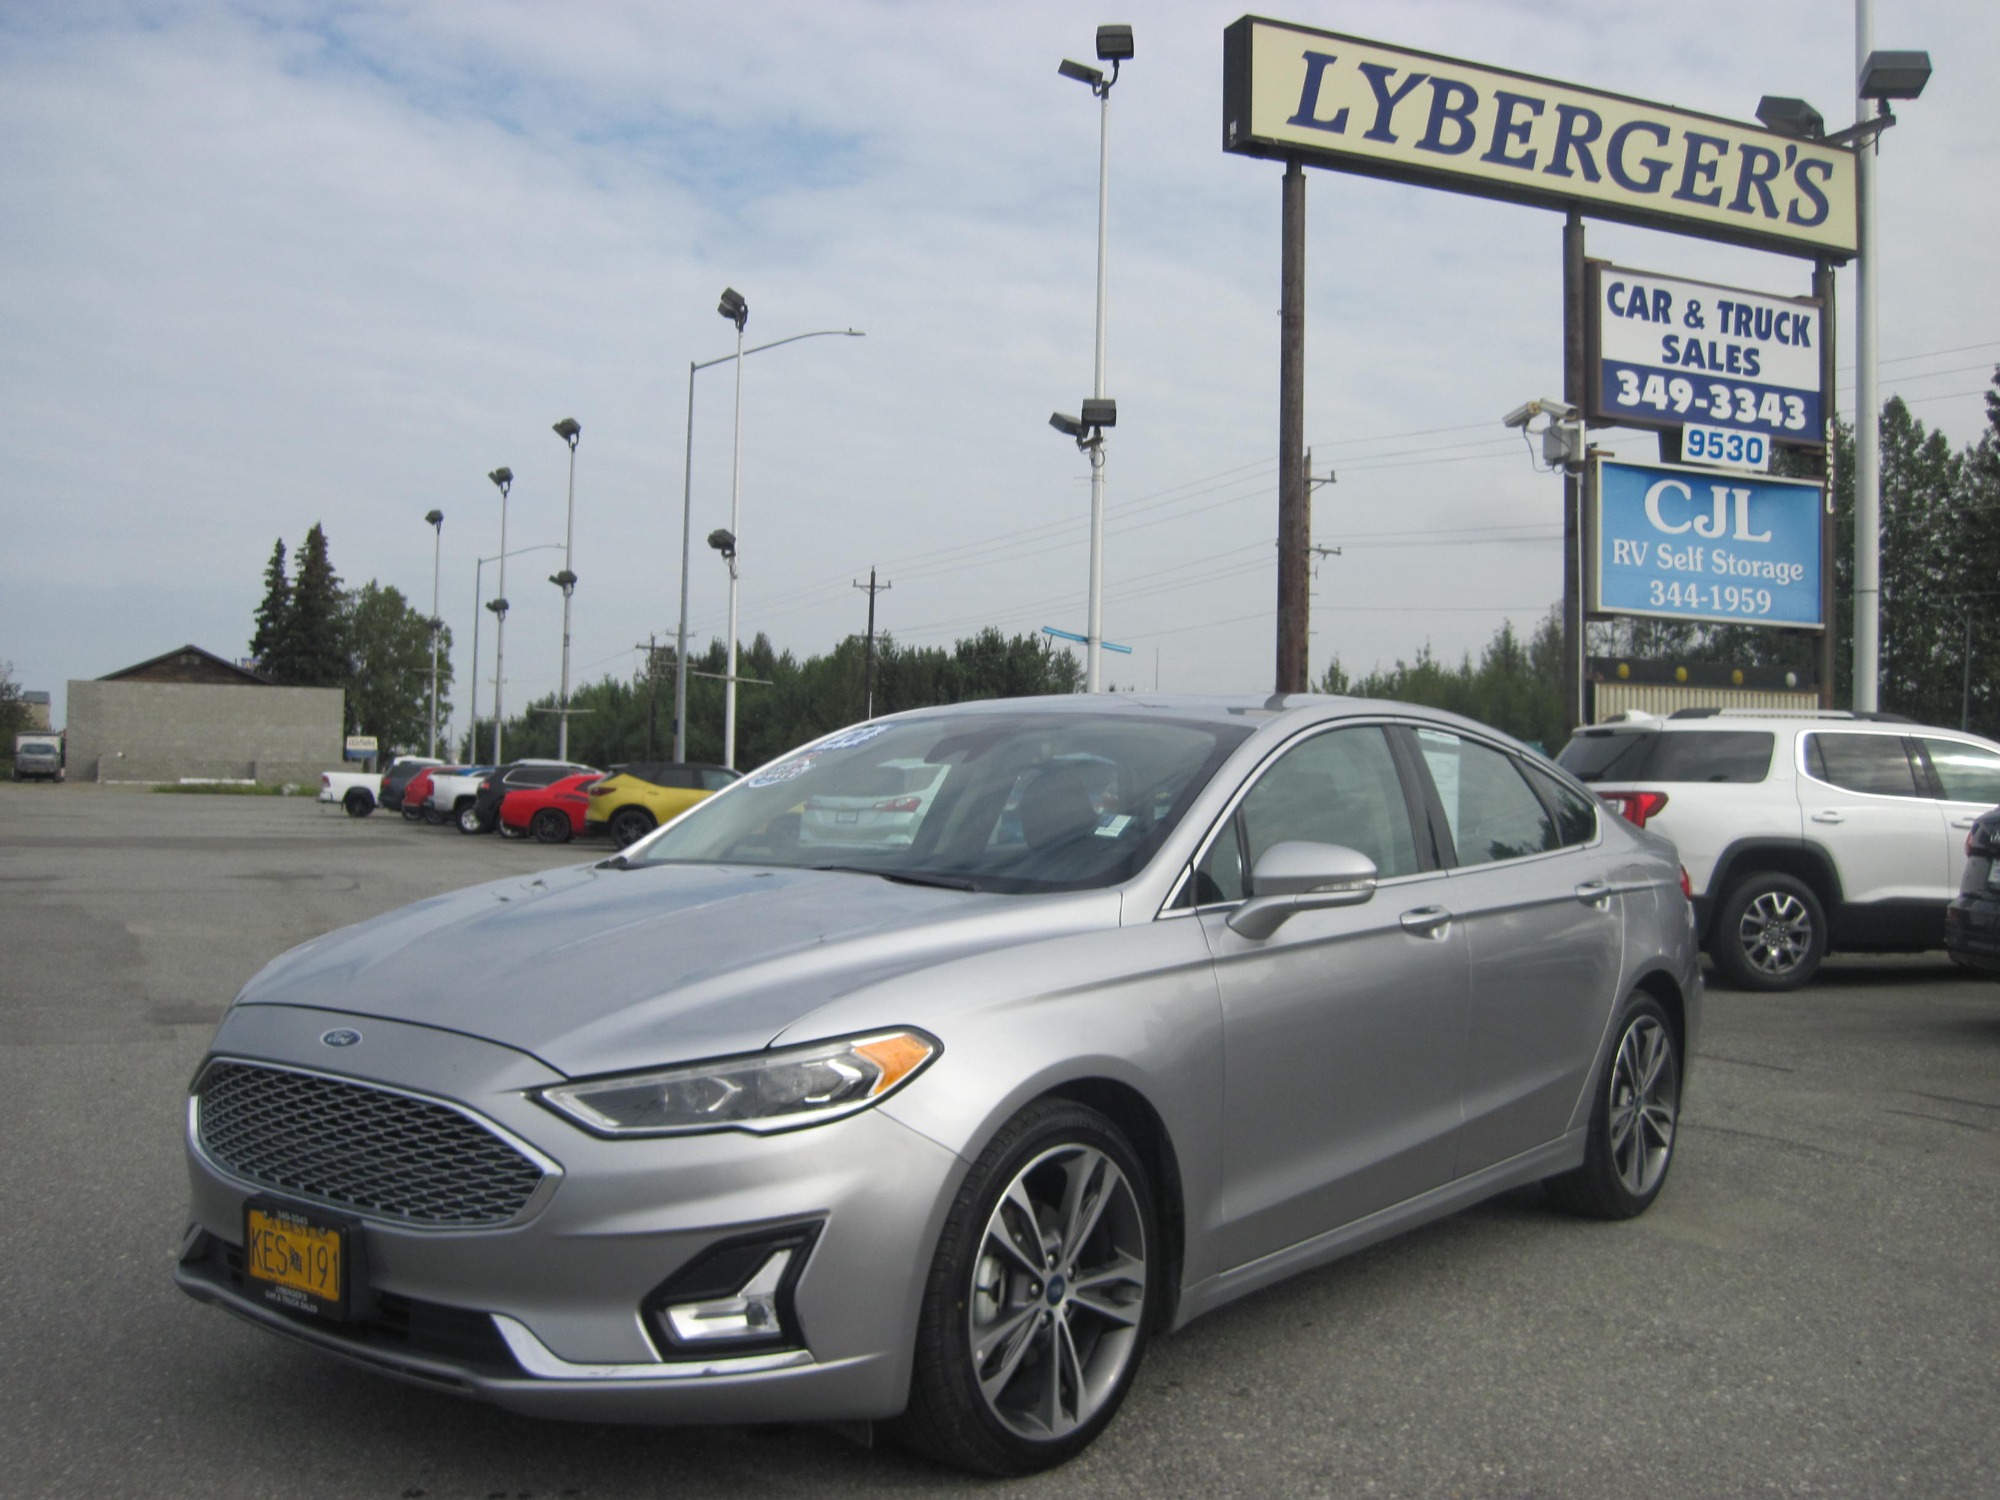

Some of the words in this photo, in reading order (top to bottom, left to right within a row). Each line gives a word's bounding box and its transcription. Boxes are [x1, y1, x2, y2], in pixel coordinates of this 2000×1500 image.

[1286, 50, 1834, 228] LYBERGER'S
[1607, 282, 1672, 324] CAR
[1683, 299, 1705, 330] &
[1717, 300, 1811, 348] TRUCK
[1661, 334, 1761, 377] SALES
[1616, 370, 1806, 431] 349-3343
[1687, 429, 1763, 464] 9530
[1644, 479, 1772, 543] CJL
[1613, 539, 1648, 566] RV
[1656, 543, 1703, 572] Self
[1712, 549, 1804, 585] Storage
[1650, 580, 1772, 614] 344-1959
[251, 1227, 288, 1276] KES
[307, 1242, 340, 1293] 191
